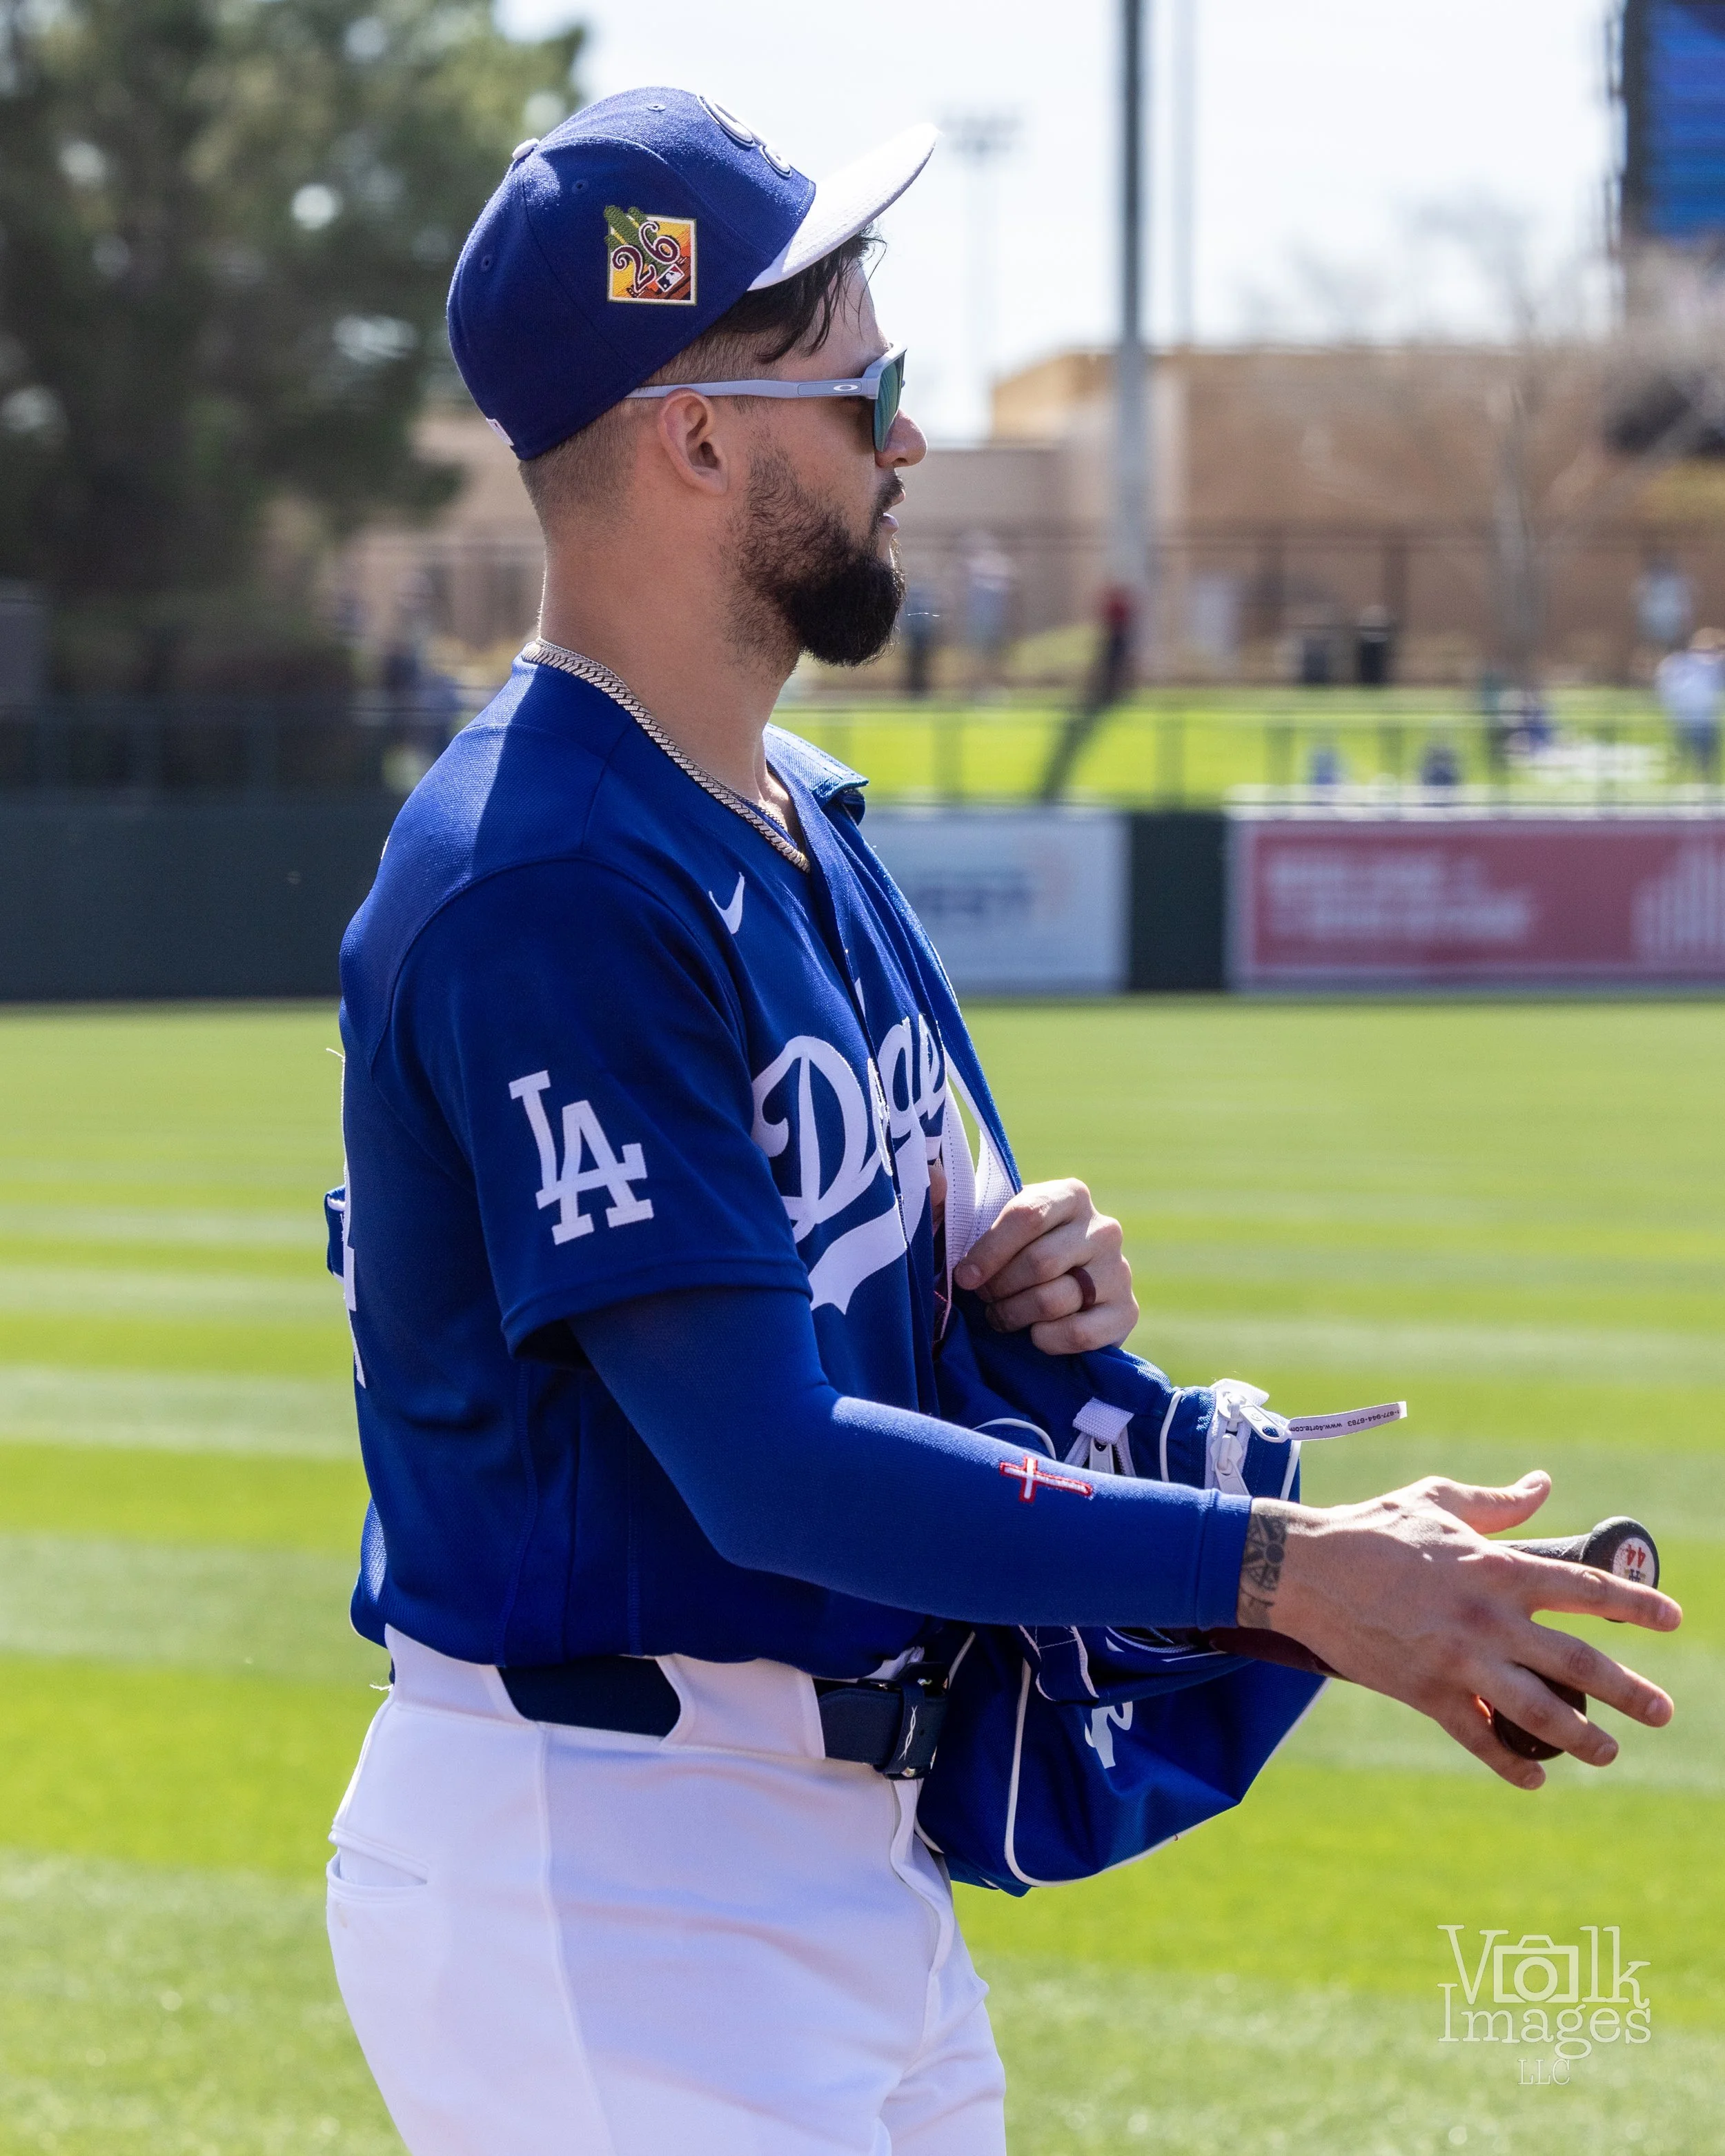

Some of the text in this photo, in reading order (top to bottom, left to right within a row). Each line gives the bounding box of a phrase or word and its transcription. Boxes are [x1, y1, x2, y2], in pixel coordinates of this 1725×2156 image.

[612, 221, 680, 293] 26
[509, 1069, 654, 1245] LA
[1628, 1544, 1646, 1567] 44
